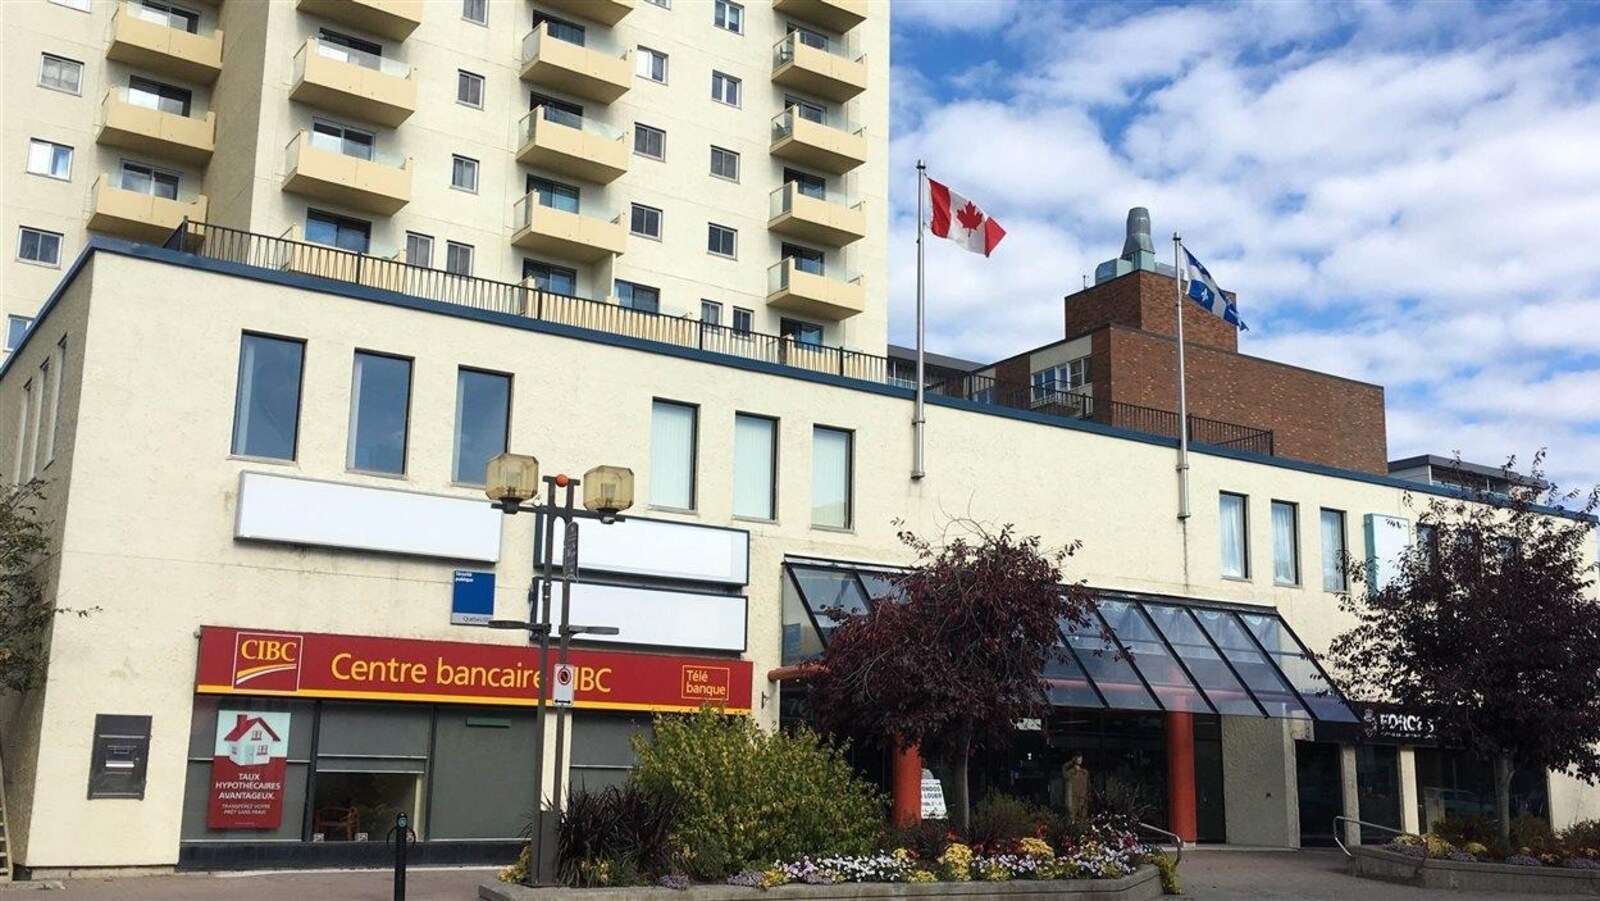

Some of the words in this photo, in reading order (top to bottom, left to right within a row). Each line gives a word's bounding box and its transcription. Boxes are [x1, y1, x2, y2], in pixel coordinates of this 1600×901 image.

[241, 639, 297, 662] CIBC
[331, 652, 428, 684] Centre
[573, 666, 612, 693] IBC
[686, 669, 709, 682] Télé
[686, 681, 726, 697] banque
[237, 772, 261, 781] TAUX
[215, 780, 281, 790] HYPOTHÉCAIRES
[218, 791, 275, 800] AVANTAGEUX.
